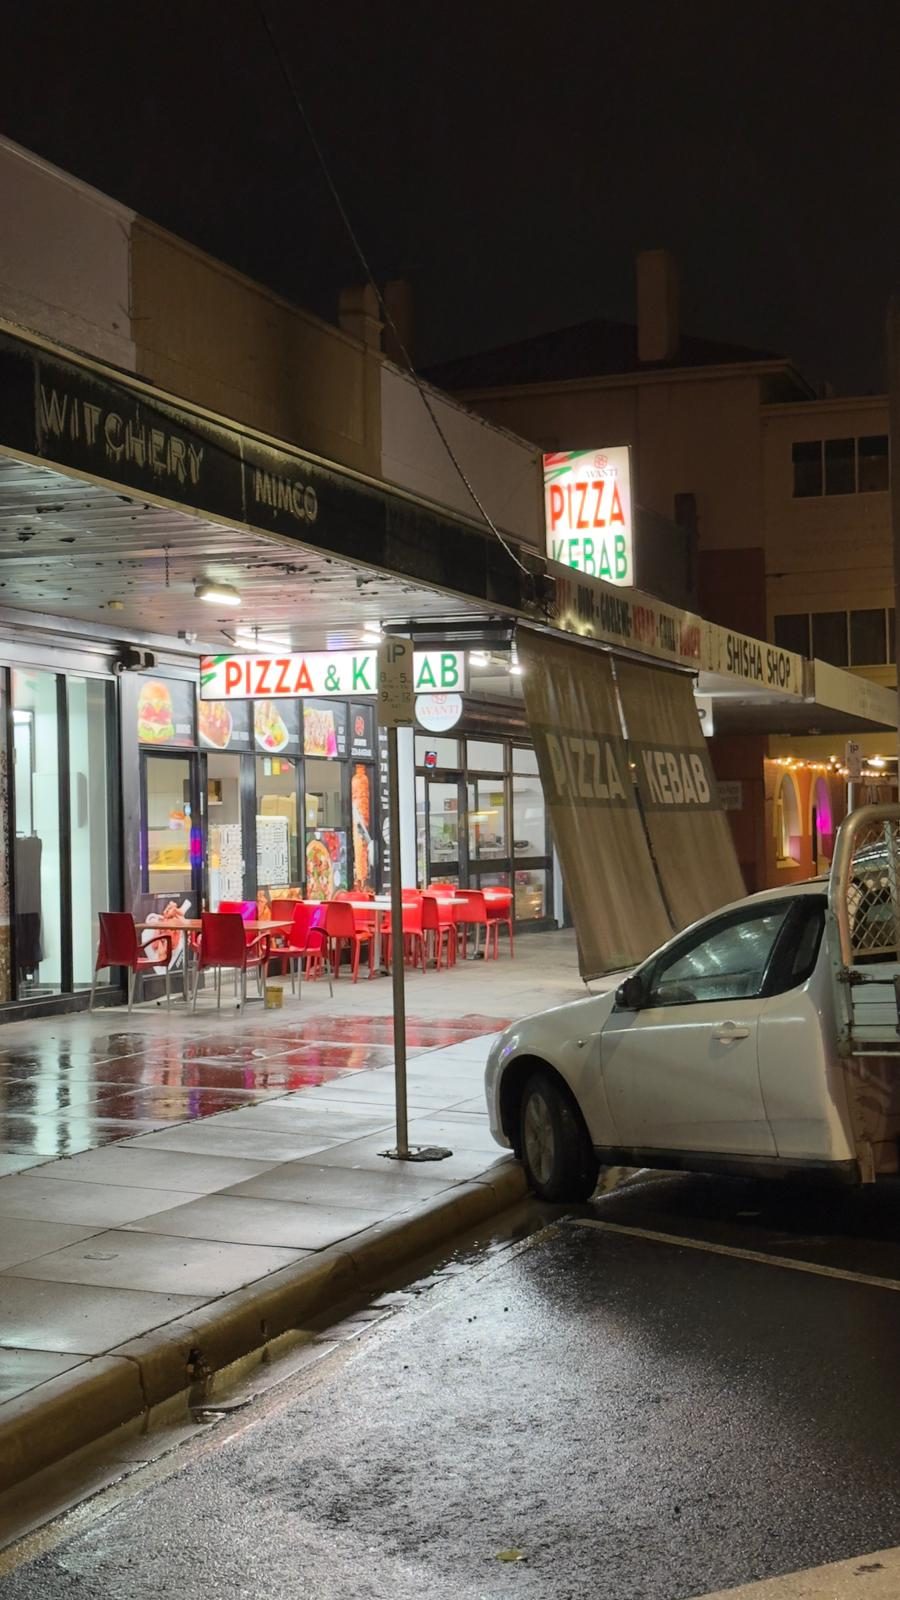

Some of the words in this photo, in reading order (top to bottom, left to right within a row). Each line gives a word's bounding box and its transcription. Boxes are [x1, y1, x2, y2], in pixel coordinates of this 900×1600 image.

[39, 384, 203, 484] WITCHERY
[254, 468, 318, 522] MIMCO
[550, 480, 625, 531] PIZZA
[552, 534, 627, 580] KEBAB
[225, 659, 314, 695] PIZZA
[324, 664, 341, 691] &
[387, 643, 406, 664] 1P
[726, 634, 763, 681] SHISHA
[766, 648, 790, 688] SHOP
[545, 734, 626, 800] PIZZA
[642, 750, 710, 804] KEBAB
